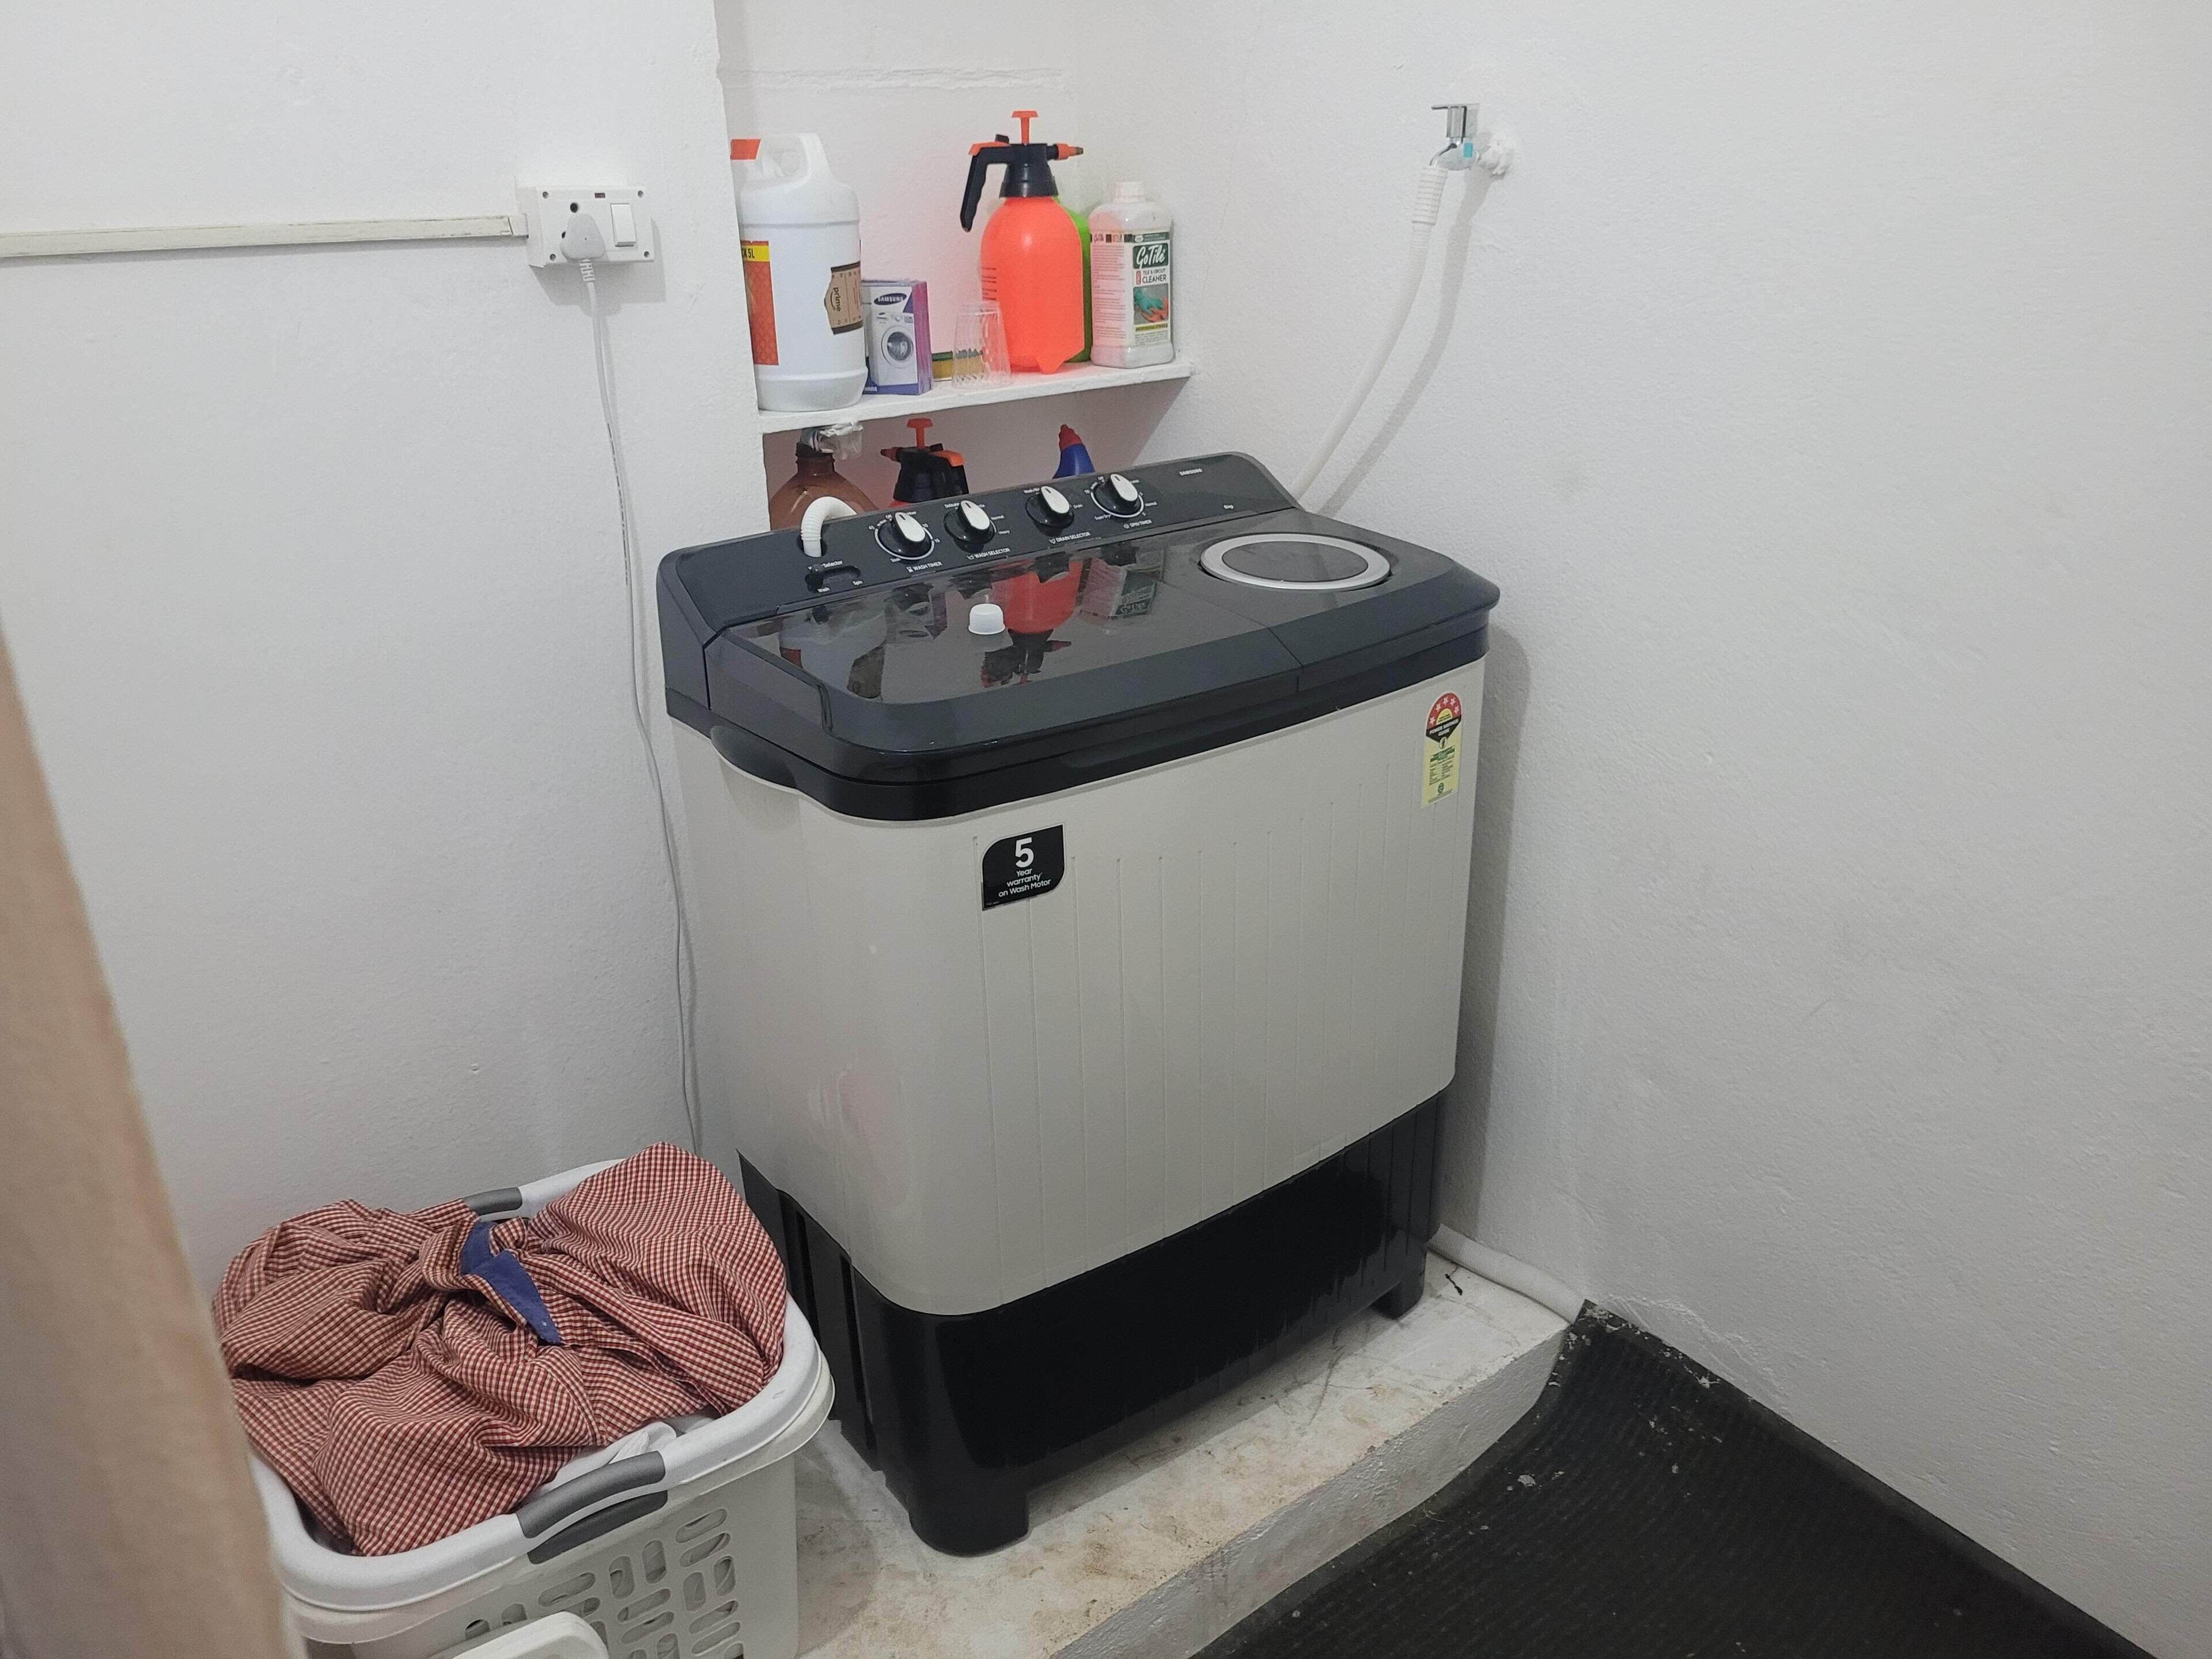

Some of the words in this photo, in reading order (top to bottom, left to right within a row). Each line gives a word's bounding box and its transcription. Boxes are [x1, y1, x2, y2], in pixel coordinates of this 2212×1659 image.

[748, 248, 755, 258] 5L
[1142, 274, 1166, 283] CLEANER
[833, 287, 842, 312] prime
[1056, 535, 1070, 543] DRAIN
[1069, 532, 1092, 540] SELECTOR
[988, 547, 1011, 556] SELECTOR
[1015, 836, 1035, 868] 5
[1016, 868, 1033, 877] Year
[1009, 885, 1030, 895] Wash
[1031, 879, 1051, 889] Motor
